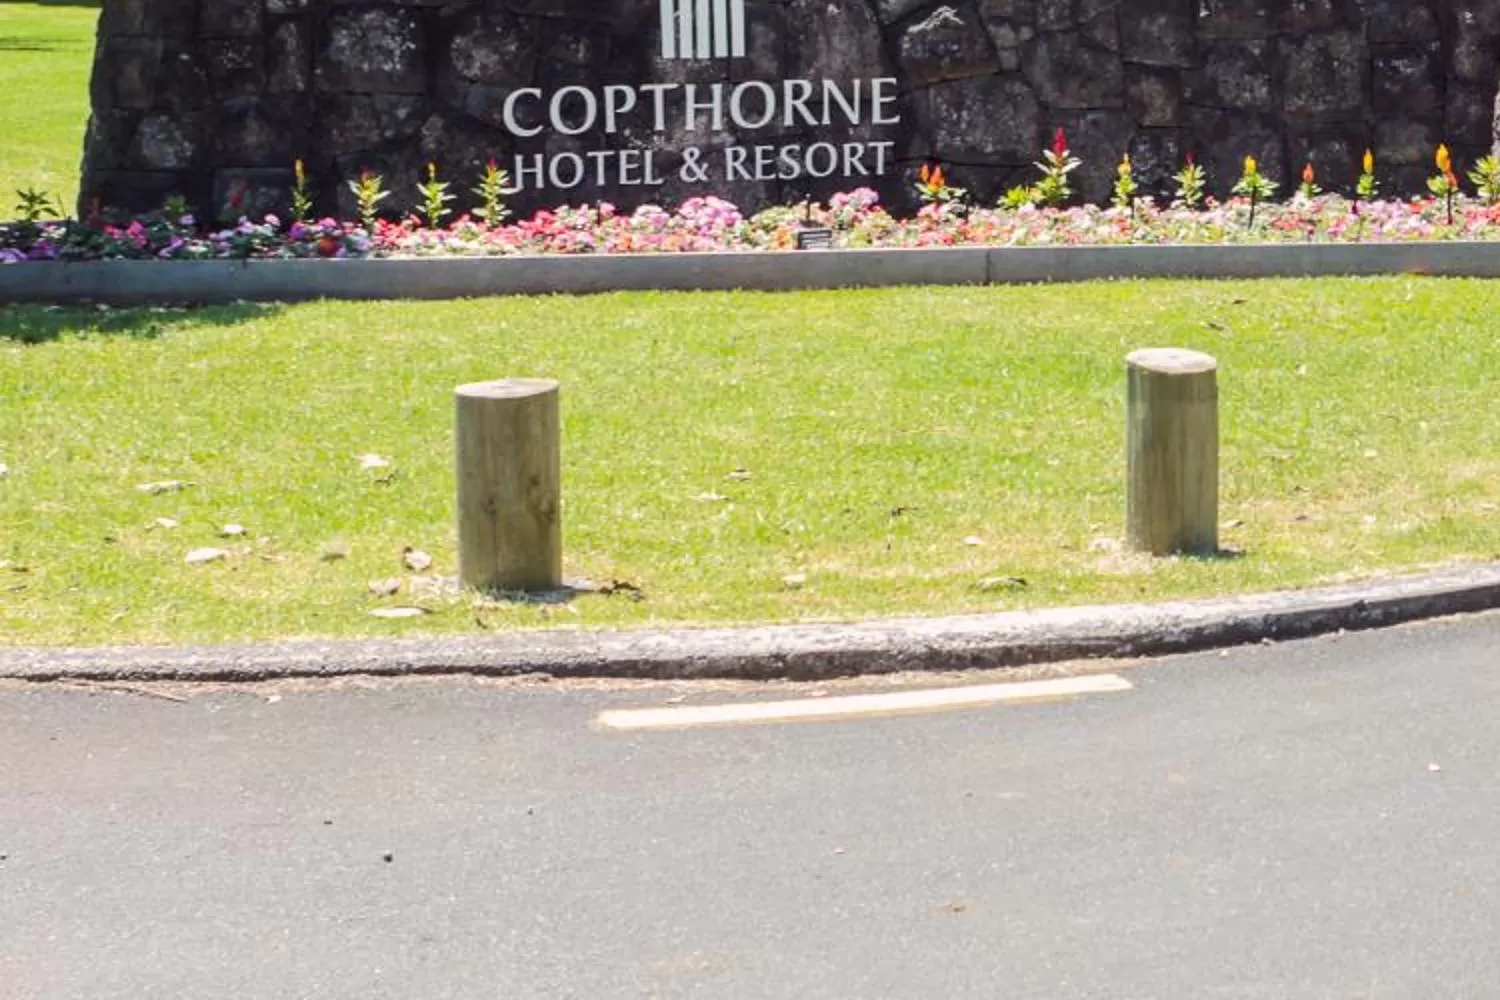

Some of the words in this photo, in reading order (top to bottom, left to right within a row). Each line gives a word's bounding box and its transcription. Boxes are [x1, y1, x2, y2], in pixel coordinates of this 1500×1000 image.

[502, 76, 901, 137] COPTHORNE
[512, 149, 665, 190] HOTEL
[679, 146, 709, 182] &
[725, 140, 895, 181] RESORT
